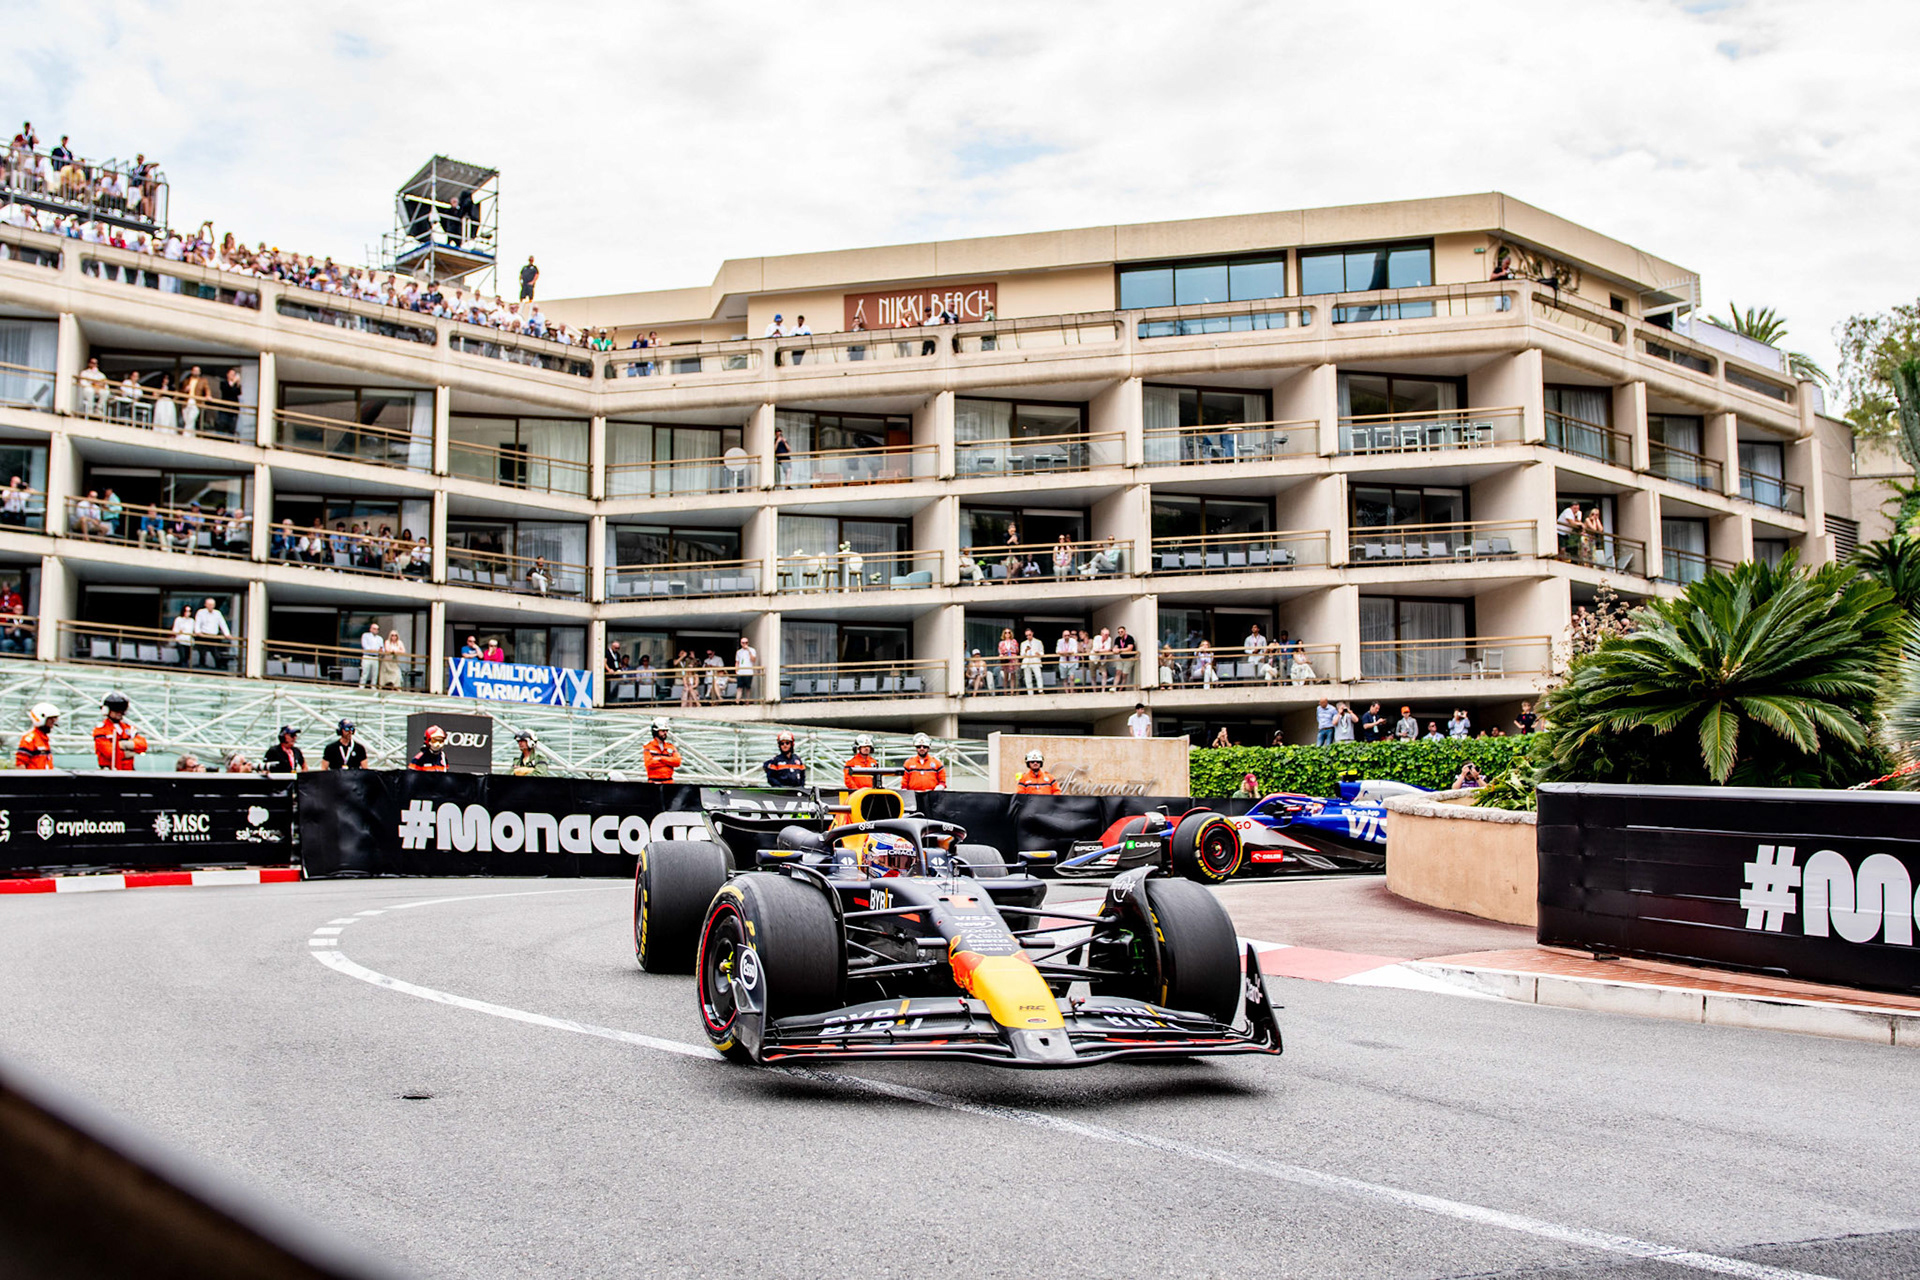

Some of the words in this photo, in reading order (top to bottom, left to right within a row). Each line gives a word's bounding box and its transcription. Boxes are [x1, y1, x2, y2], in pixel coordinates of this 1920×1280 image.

[878, 295, 923, 325] NIKKI
[931, 290, 989, 319] BEACH
[467, 661, 549, 684] HAMILTON
[473, 681, 543, 703] TARMAC
[1051, 761, 1157, 796] Fairmont
[56, 820, 126, 837] crypto.com
[172, 814, 210, 833] MSC
[870, 887, 894, 910] BYBIT
[1740, 844, 1920, 946] #M
